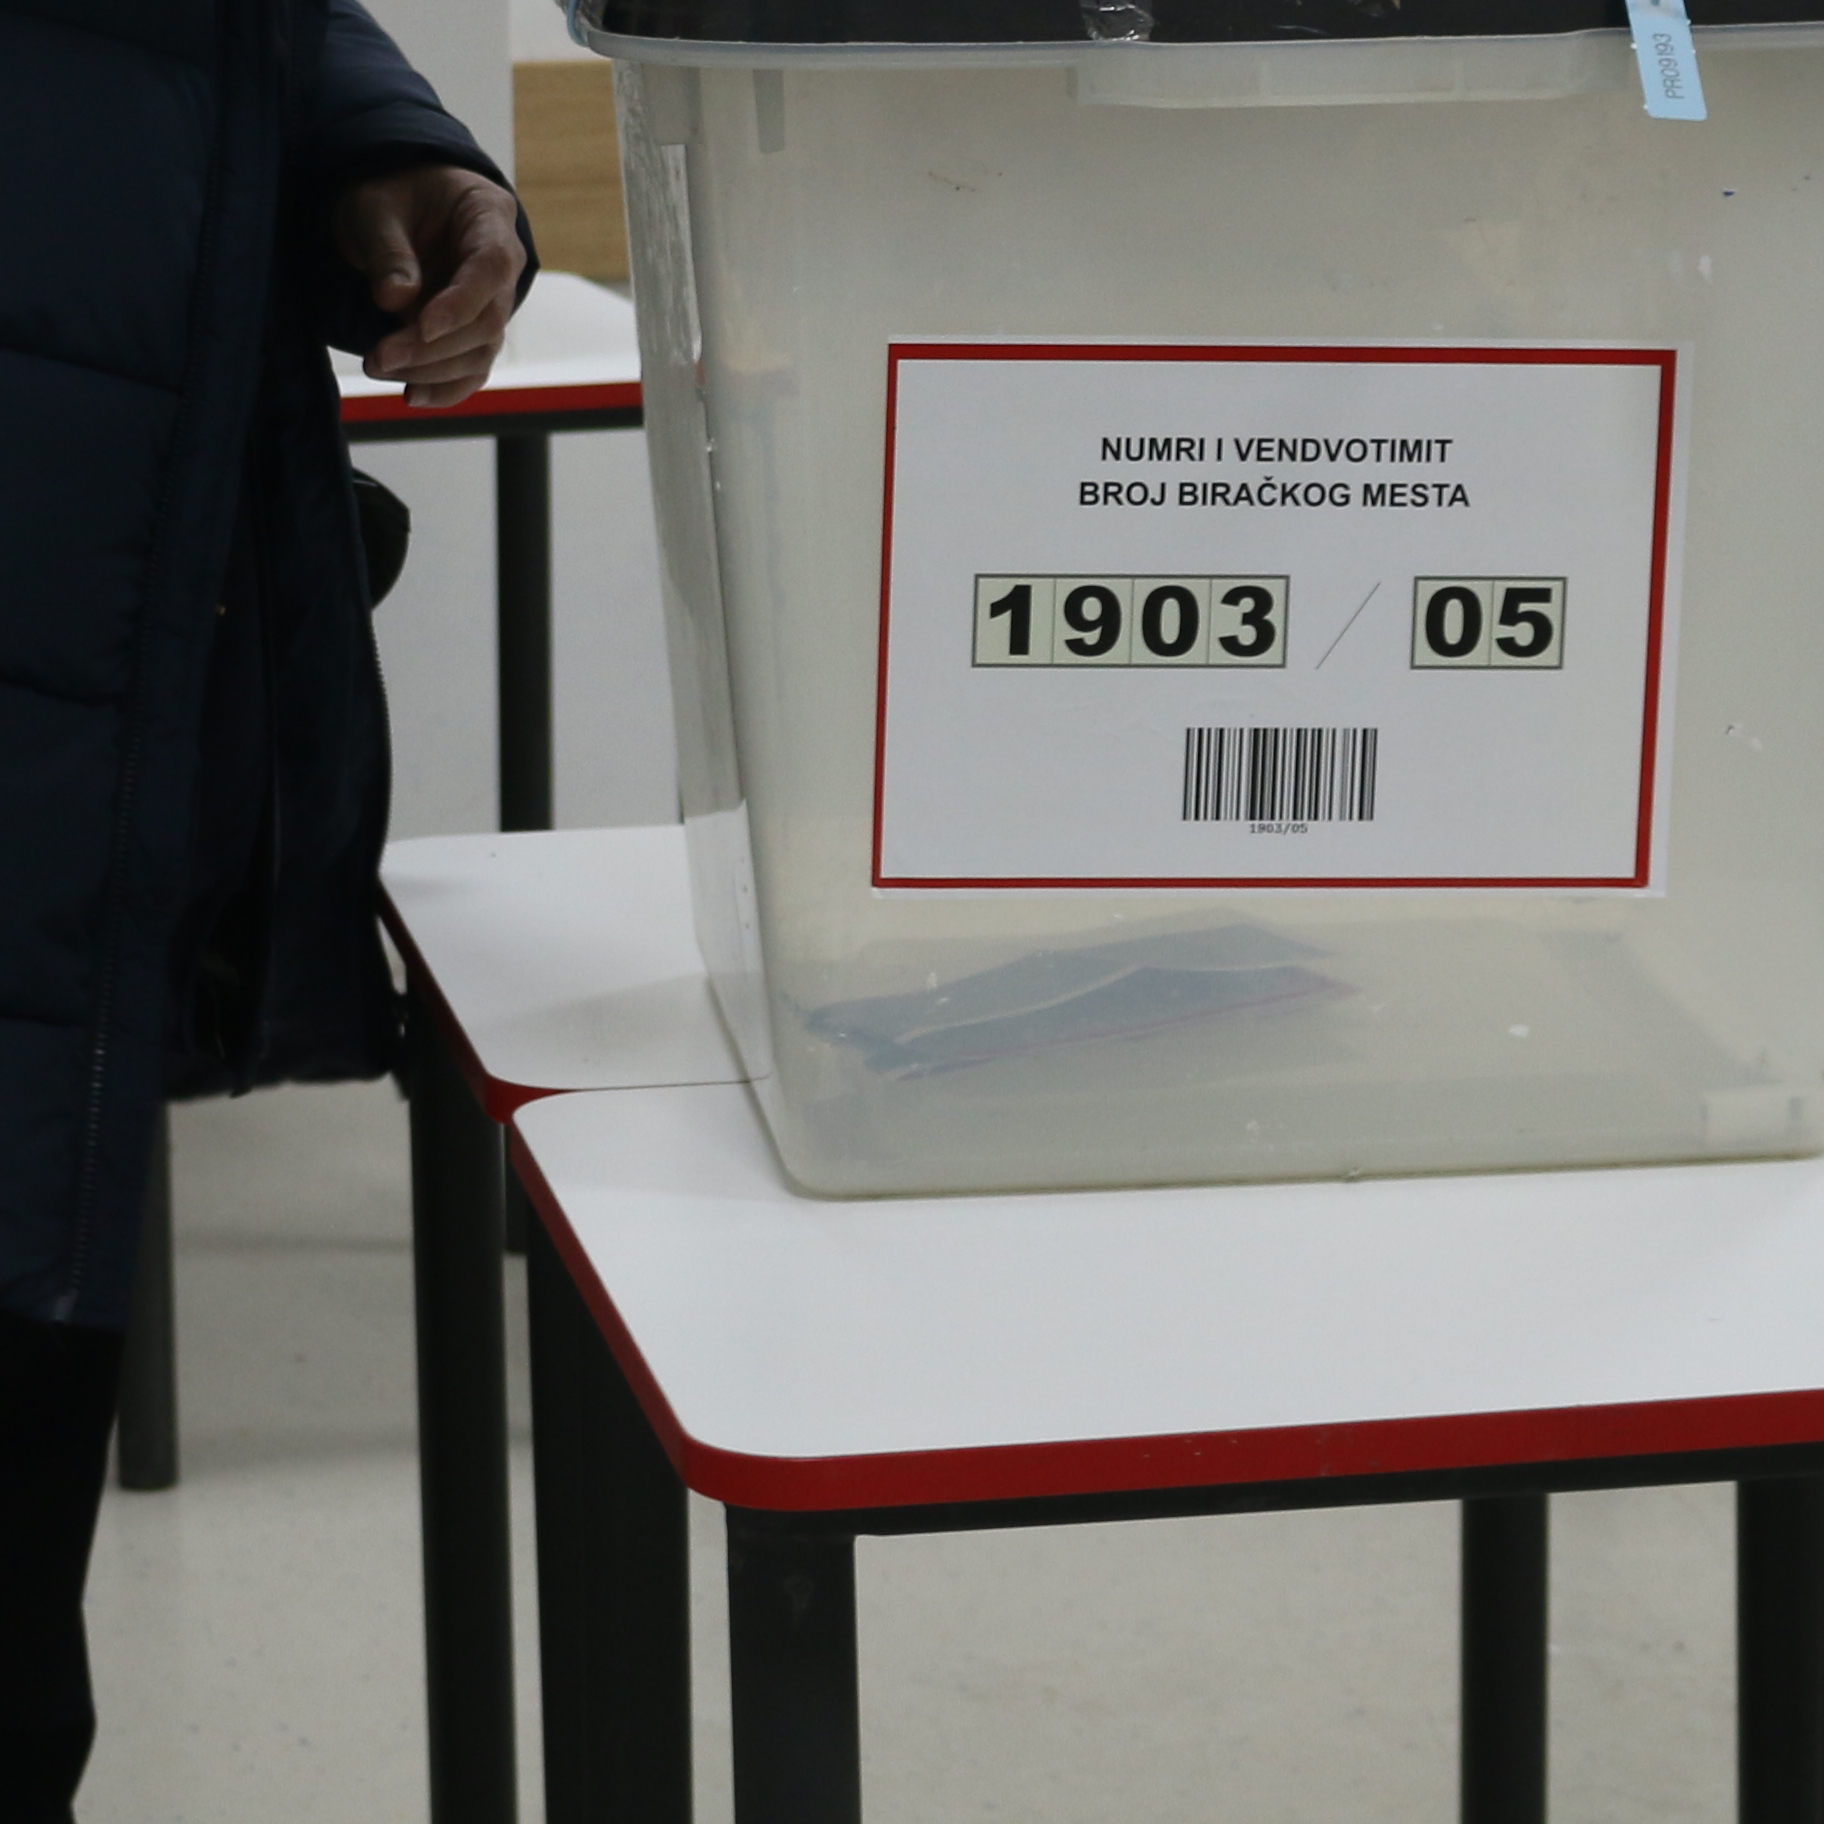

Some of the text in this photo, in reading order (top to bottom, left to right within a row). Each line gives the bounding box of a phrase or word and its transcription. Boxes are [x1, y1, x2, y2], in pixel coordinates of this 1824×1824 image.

[1100, 436, 1453, 464] NUMRI I VENDVOTIMIT
[1078, 474, 1471, 508] BROJ BIRAČKOG MESTA
[987, 583, 1278, 658] 1903
[1424, 585, 1554, 659] 05
[1250, 822, 1309, 836] 1903/05
